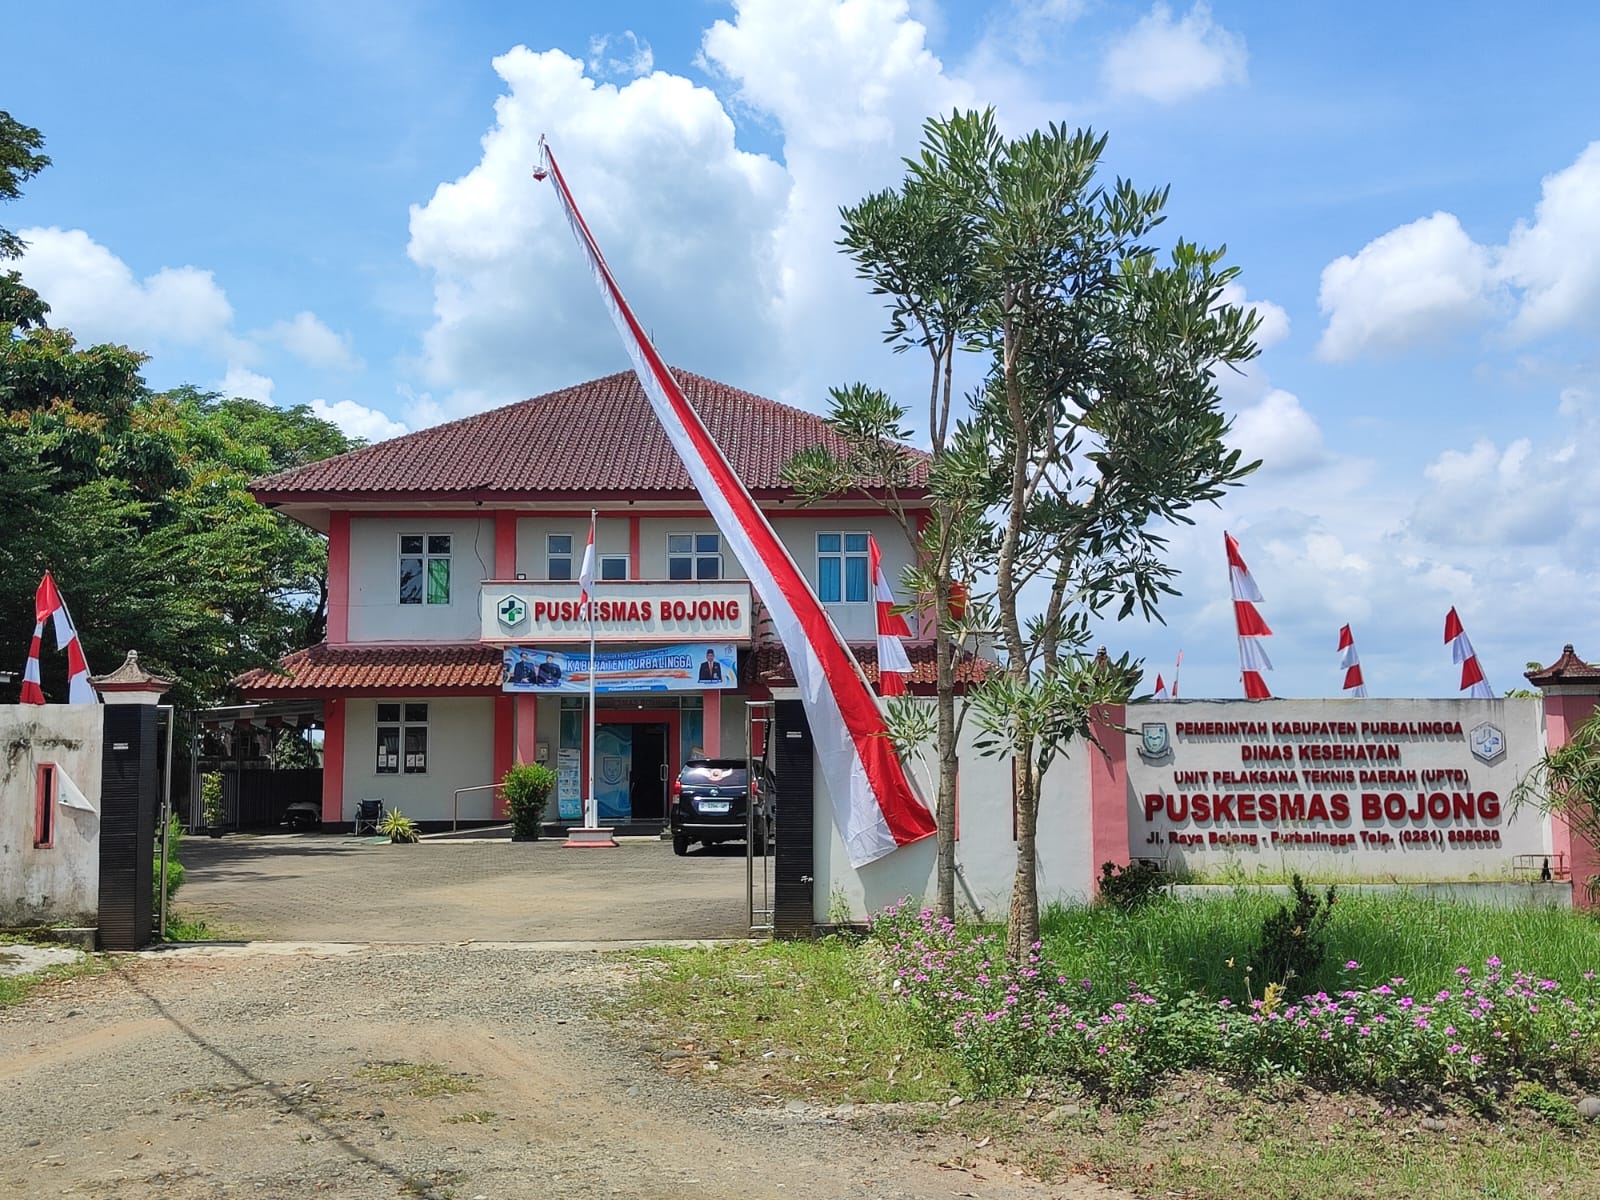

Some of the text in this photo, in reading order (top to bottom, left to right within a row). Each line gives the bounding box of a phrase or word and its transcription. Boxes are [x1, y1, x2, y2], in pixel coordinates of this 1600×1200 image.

[660, 600, 739, 621] BOJONG
[628, 655, 692, 670] PURBALINGGA
[1176, 722, 1463, 735] PEMERINTAH KABUPATEN PURBALINGGA
[1241, 745, 1399, 761] DINAS KESEHATAN
[1174, 769, 1469, 785] UNIT PELAKSANA TEKNIS DAERAH (UPTD)
[1145, 791, 1500, 822] PUSKESMAS BOJONG
[1146, 832, 1164, 844] Jl.
[1169, 832, 1204, 846] Raya
[1208, 832, 1258, 847] Bojong
[1271, 831, 1355, 847] Purbalingga
[1360, 831, 1394, 845] Telp.
[1399, 829, 1443, 845] (0281)
